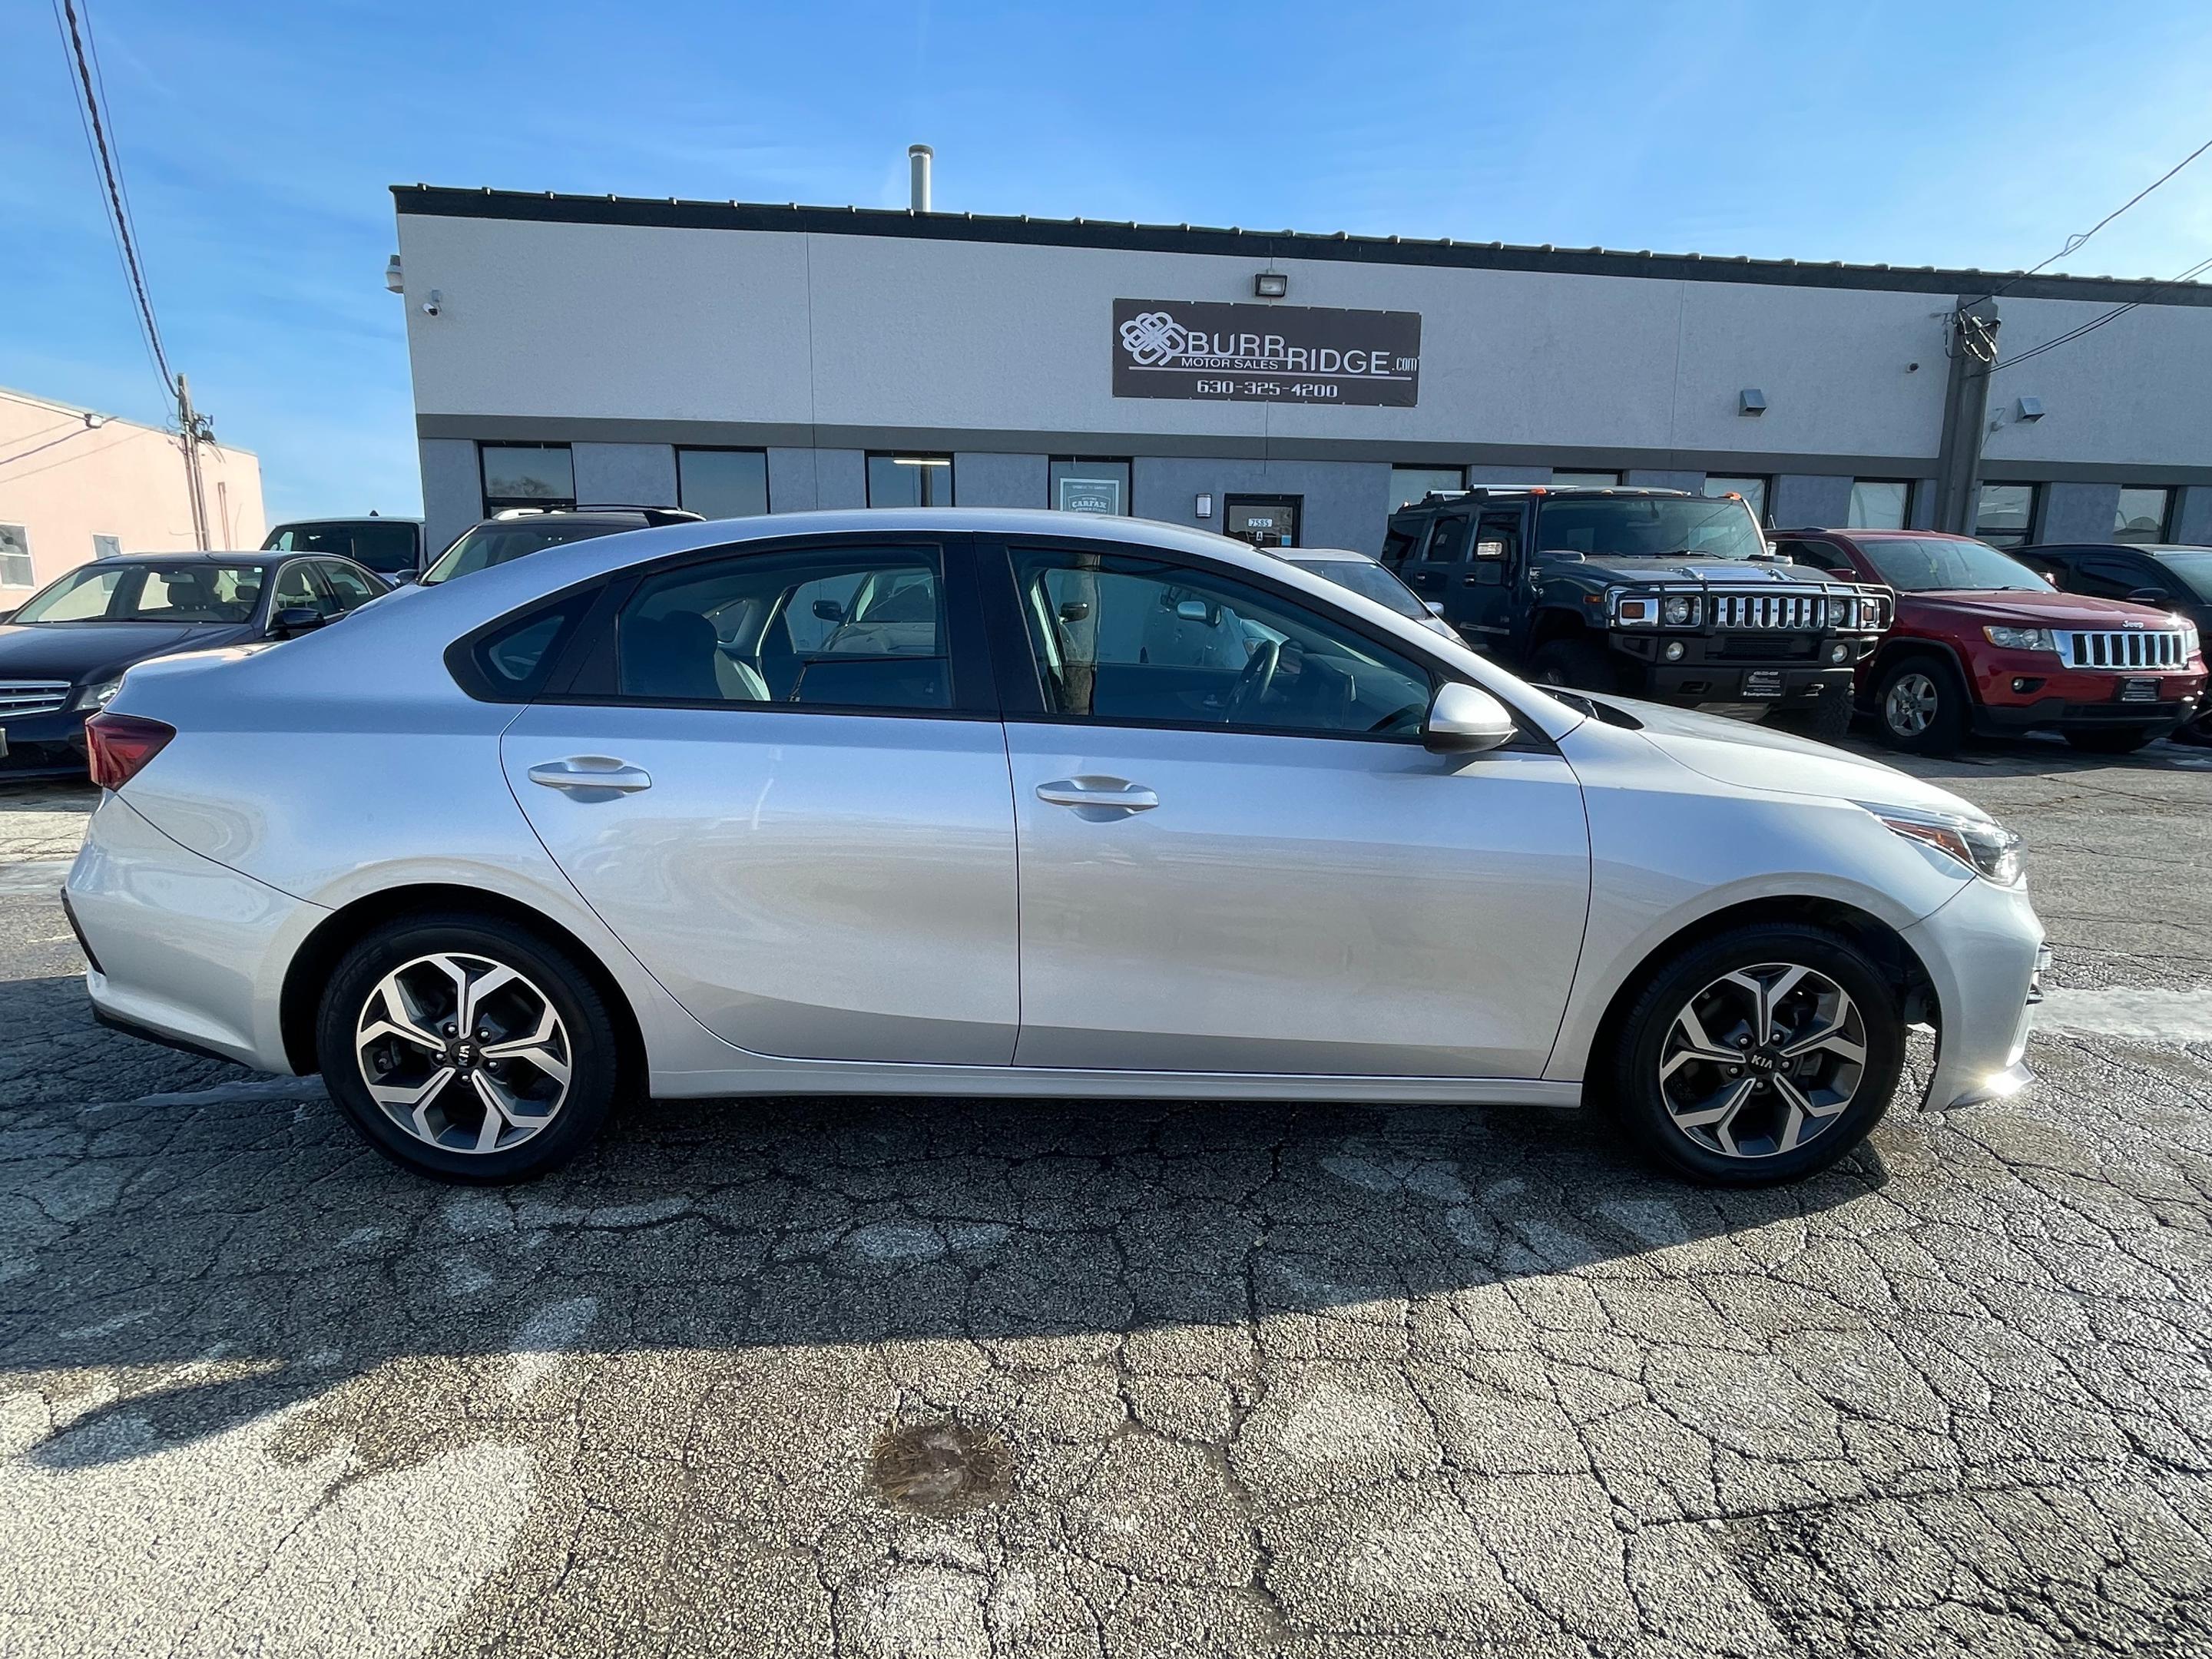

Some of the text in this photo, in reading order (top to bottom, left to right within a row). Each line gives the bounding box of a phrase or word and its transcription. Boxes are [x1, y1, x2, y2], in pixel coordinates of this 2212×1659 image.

[1187, 332, 1285, 358] BURR
[1181, 356, 1279, 370] MOTOR SALES
[1197, 379, 1339, 398] 630-325-4200
[1072, 500, 1107, 510] CARFAX
[2122, 620, 2144, 629] Jeep
[1751, 1055, 1773, 1068] KIA
